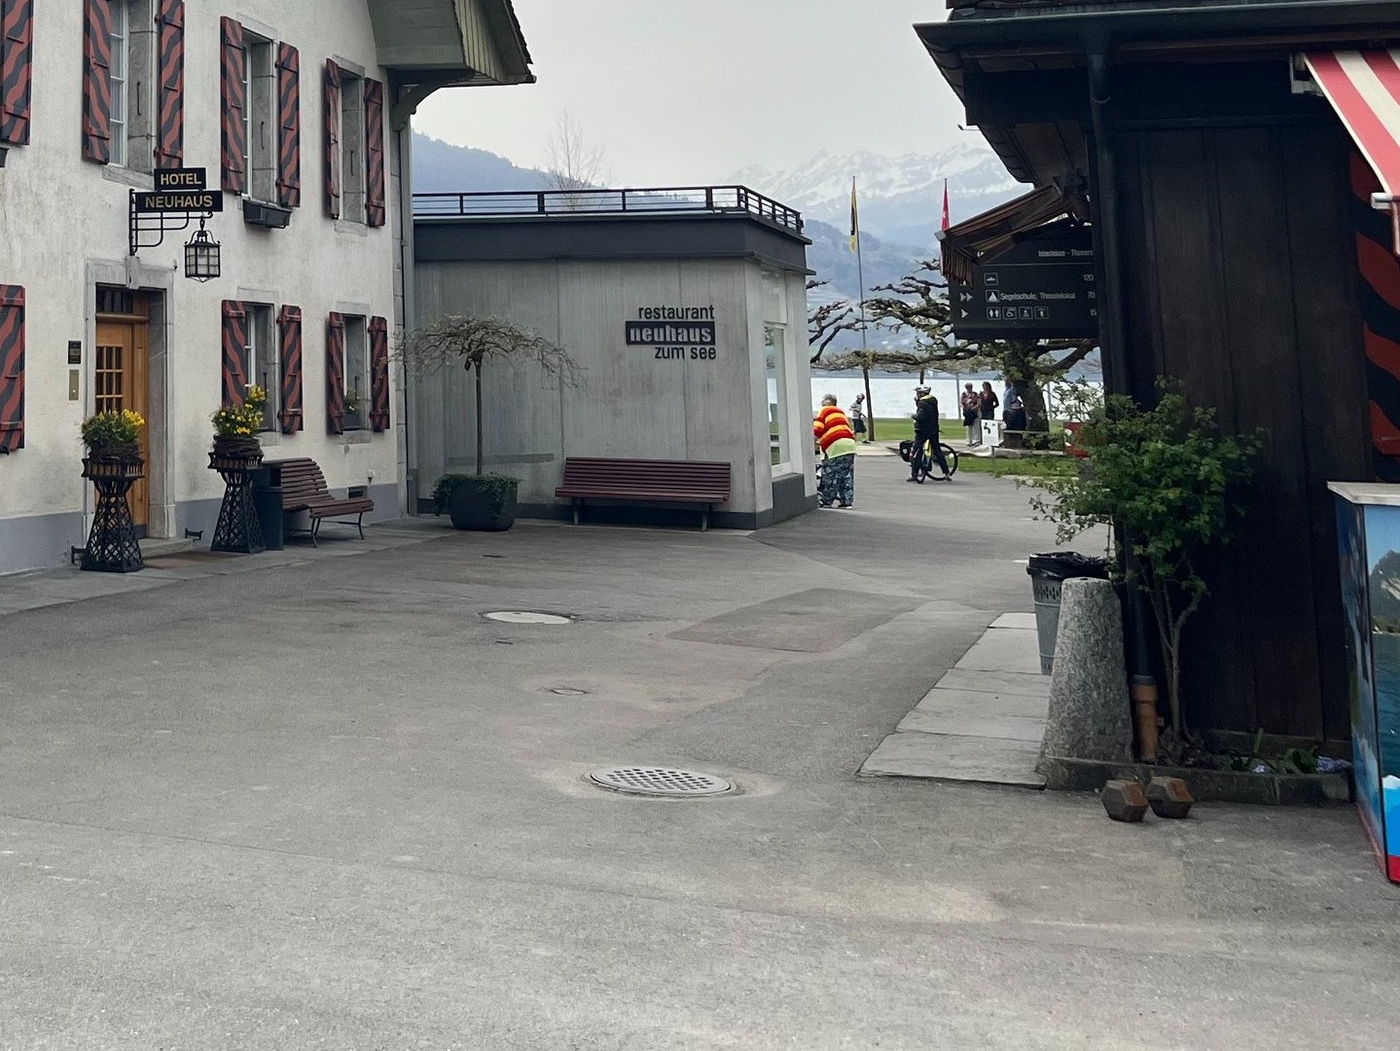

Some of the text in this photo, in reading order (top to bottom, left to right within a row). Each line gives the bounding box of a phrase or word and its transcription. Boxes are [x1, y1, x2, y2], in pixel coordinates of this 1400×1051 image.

[160, 173, 202, 185] HOTEL
[145, 195, 213, 208] NEUHAUS
[639, 305, 715, 320] restaurant
[630, 325, 712, 342] neuhaus
[654, 347, 717, 360] zum see
